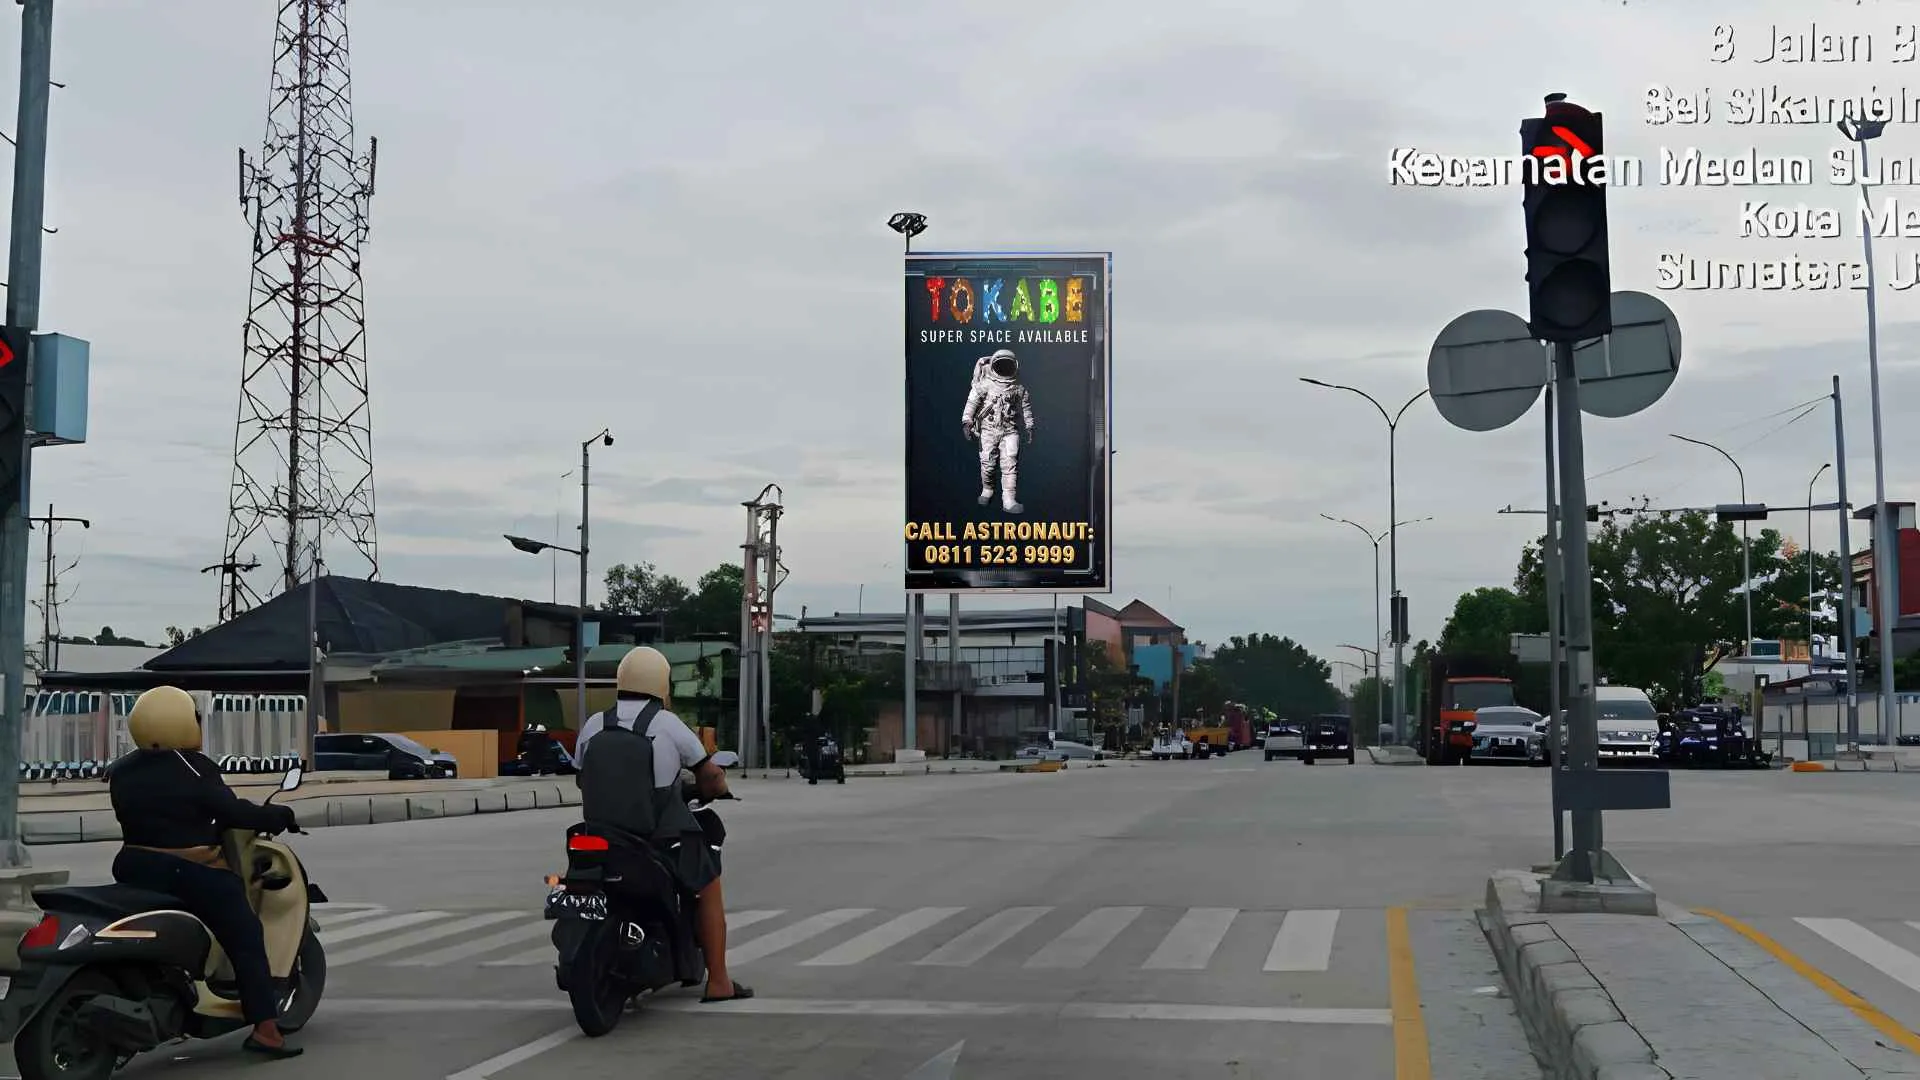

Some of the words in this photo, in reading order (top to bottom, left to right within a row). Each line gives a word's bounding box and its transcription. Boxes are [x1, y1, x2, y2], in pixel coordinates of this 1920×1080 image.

[925, 276, 1083, 324] TOKABE
[920, 330, 963, 343] SUPER
[970, 330, 1011, 343] SPACE
[1018, 330, 1089, 343] AVAILABLE
[904, 521, 957, 541] CALL
[963, 521, 1095, 541] ASTRONAUT:
[924, 545, 972, 564] 0811
[980, 545, 1018, 564] 523
[1024, 545, 1076, 564] 9999
